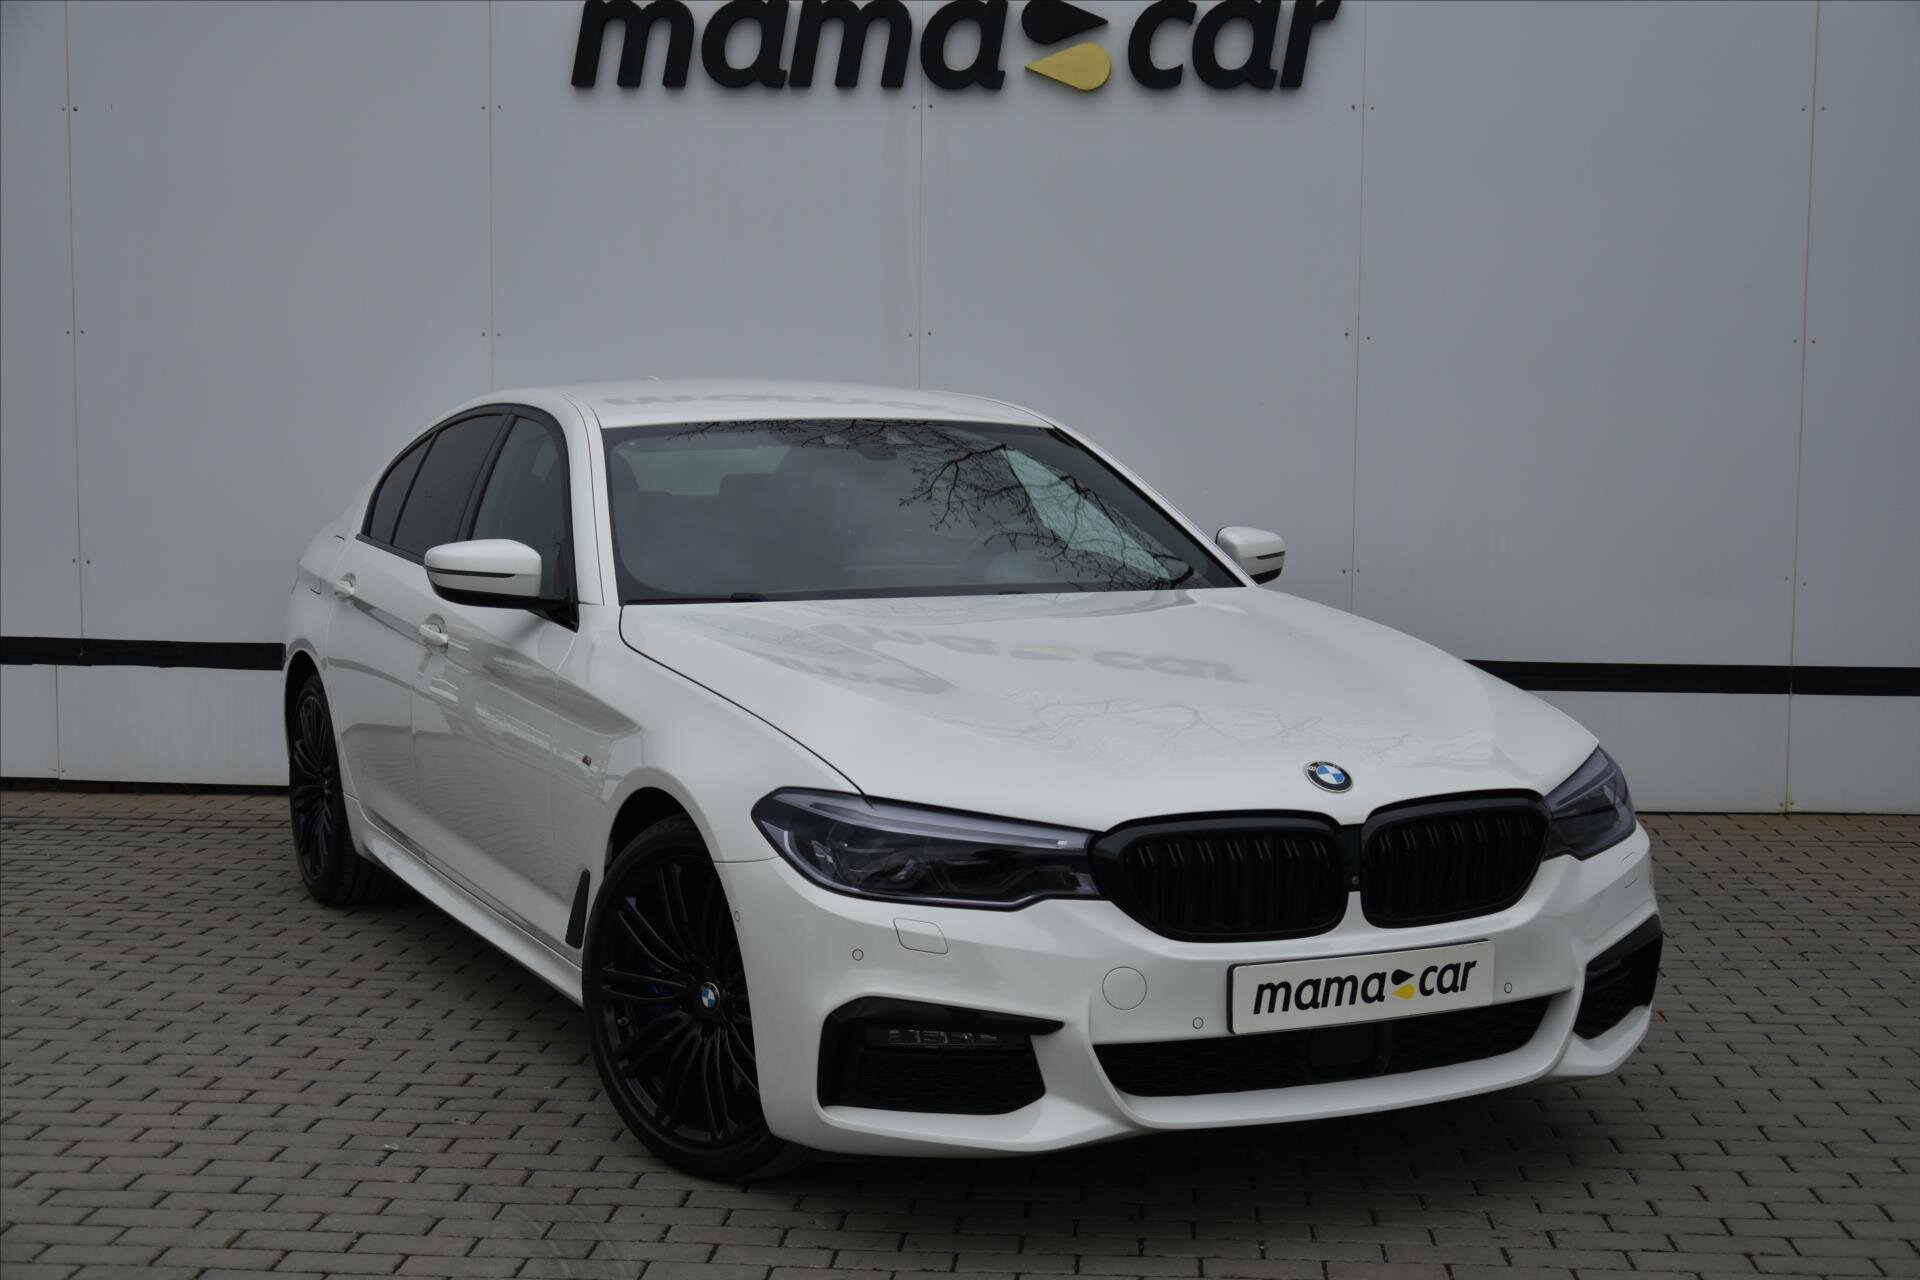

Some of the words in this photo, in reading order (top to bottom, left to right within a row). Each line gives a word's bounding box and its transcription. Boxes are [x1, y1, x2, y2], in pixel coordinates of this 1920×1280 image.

[571, 0, 1005, 92] mama
[1128, 0, 1342, 91] car
[1253, 972, 1387, 1015] mama
[1419, 960, 1477, 997] car
